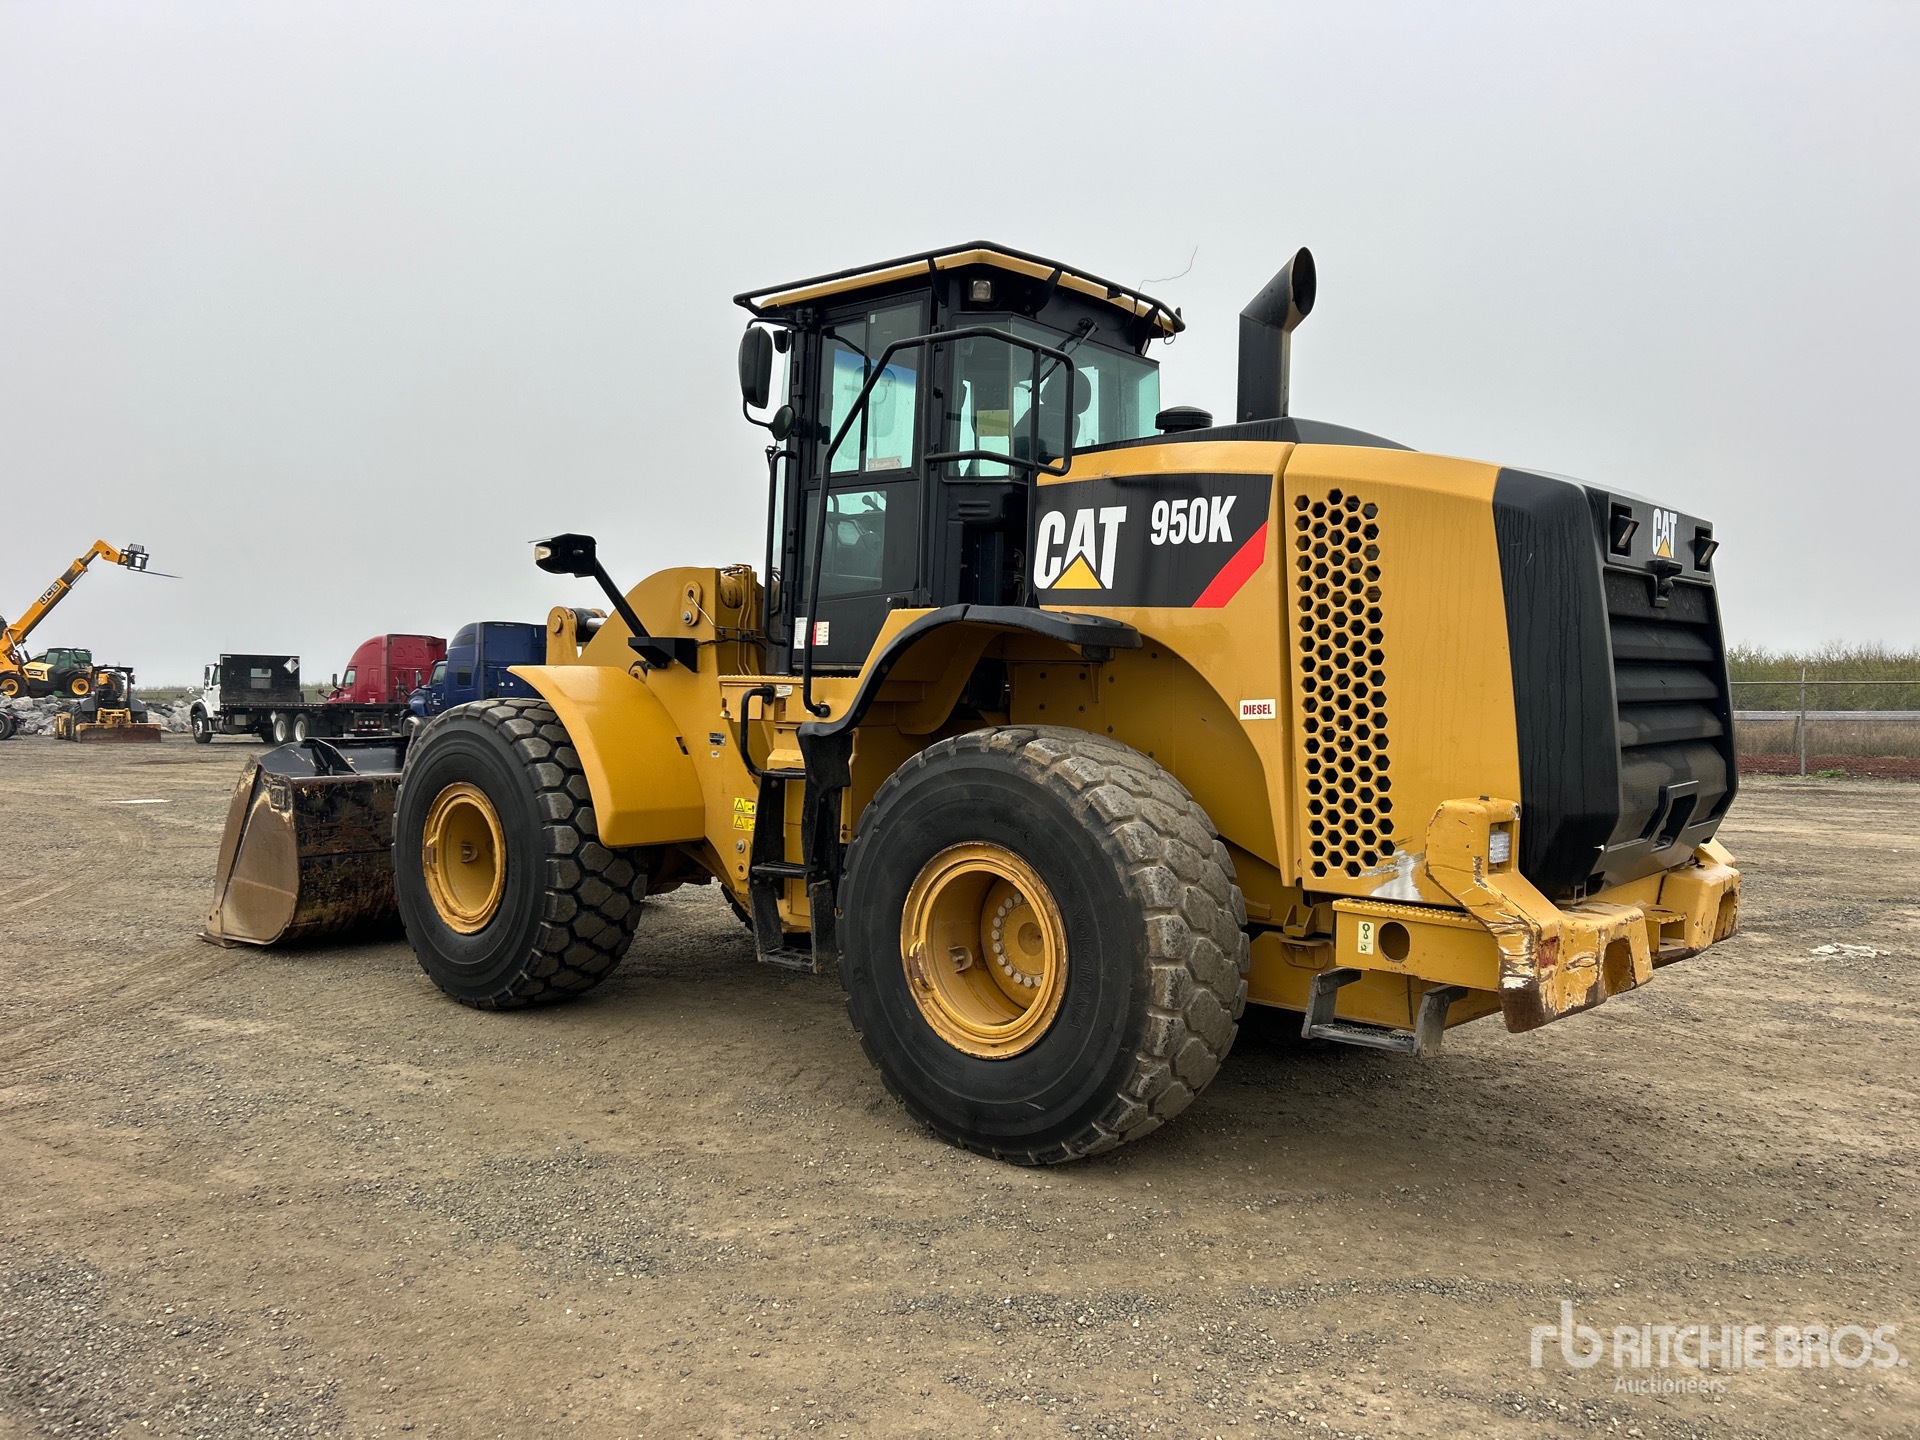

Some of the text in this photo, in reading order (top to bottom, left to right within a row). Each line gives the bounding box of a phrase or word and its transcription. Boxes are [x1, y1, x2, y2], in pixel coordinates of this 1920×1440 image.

[1150, 495, 1237, 546] 950K
[1652, 508, 1677, 559] CAT
[1033, 505, 1127, 590] CAT
[39, 581, 61, 605] JCB
[1242, 703, 1272, 716] DIESEL
[1069, 905, 1093, 1029] YOKOHAMA
